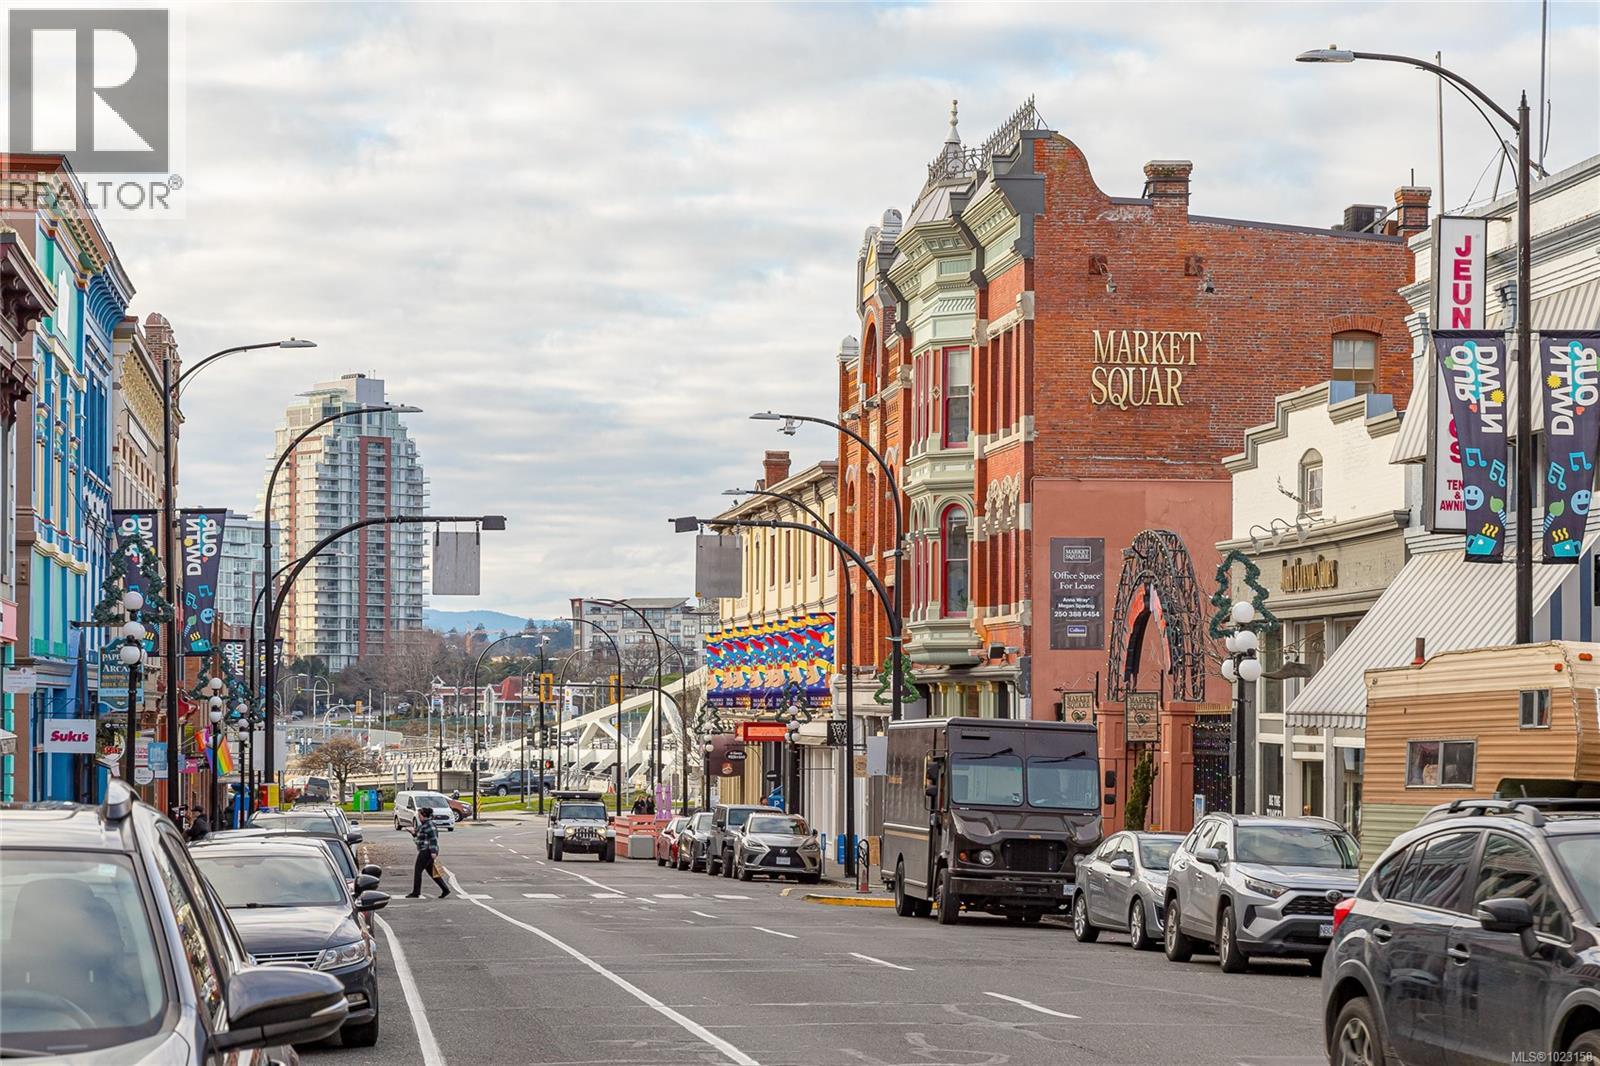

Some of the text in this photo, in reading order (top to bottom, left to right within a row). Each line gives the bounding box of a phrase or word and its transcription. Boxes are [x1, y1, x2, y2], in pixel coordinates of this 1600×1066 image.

[1092, 330, 1203, 366] MARKET
[1090, 366, 1185, 411] SQUAR
[1454, 491, 1461, 499] &
[1054, 571, 1101, 581] Office Space
[1060, 582, 1095, 590] For Lease
[51, 730, 89, 741] Suki's
